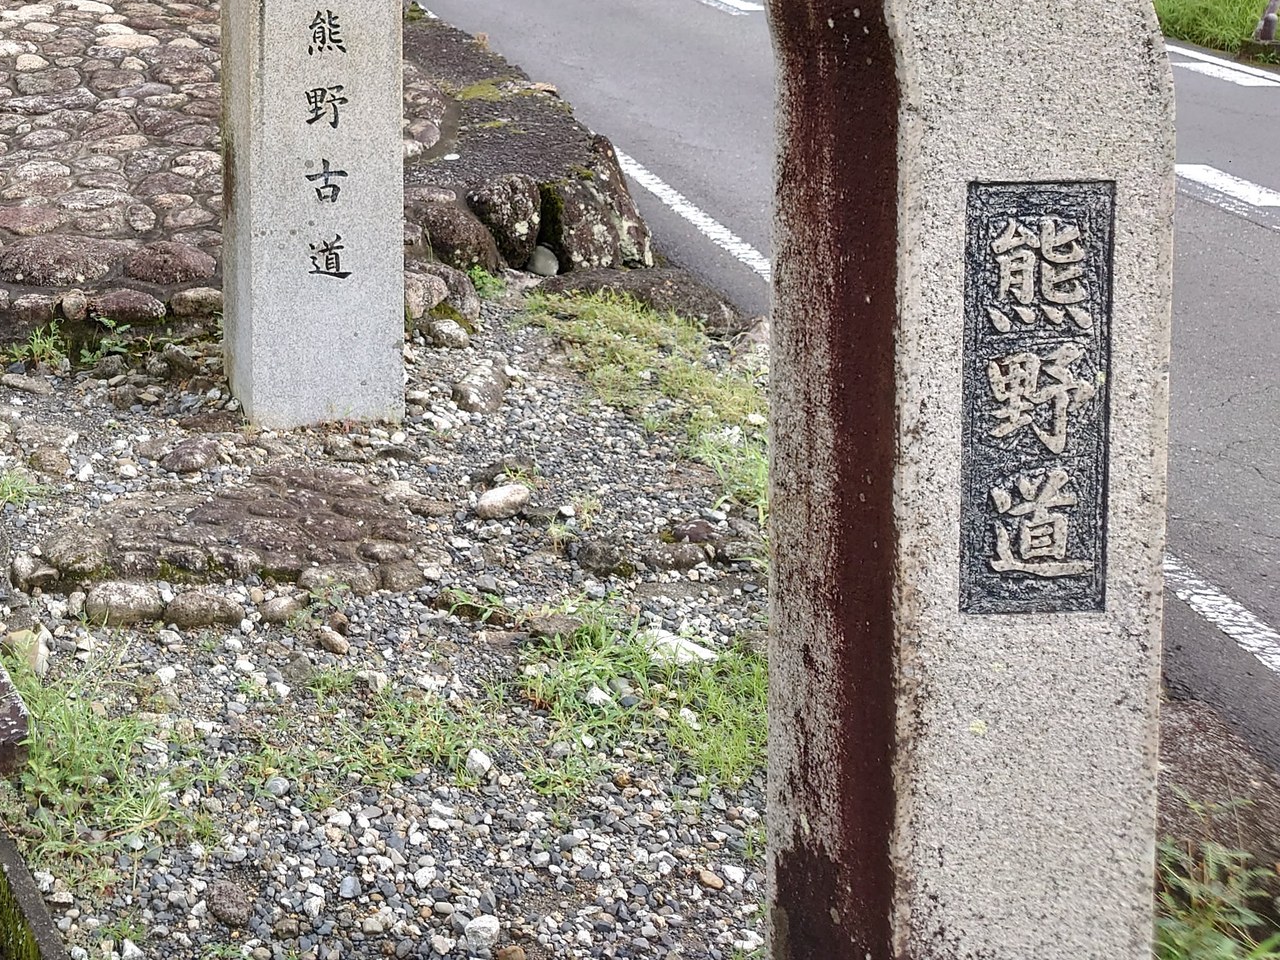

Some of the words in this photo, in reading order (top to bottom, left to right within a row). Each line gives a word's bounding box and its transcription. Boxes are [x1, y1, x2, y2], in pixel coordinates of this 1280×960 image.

[305, 9, 352, 280] 熊野古道
[986, 215, 1095, 578] 熊野道
